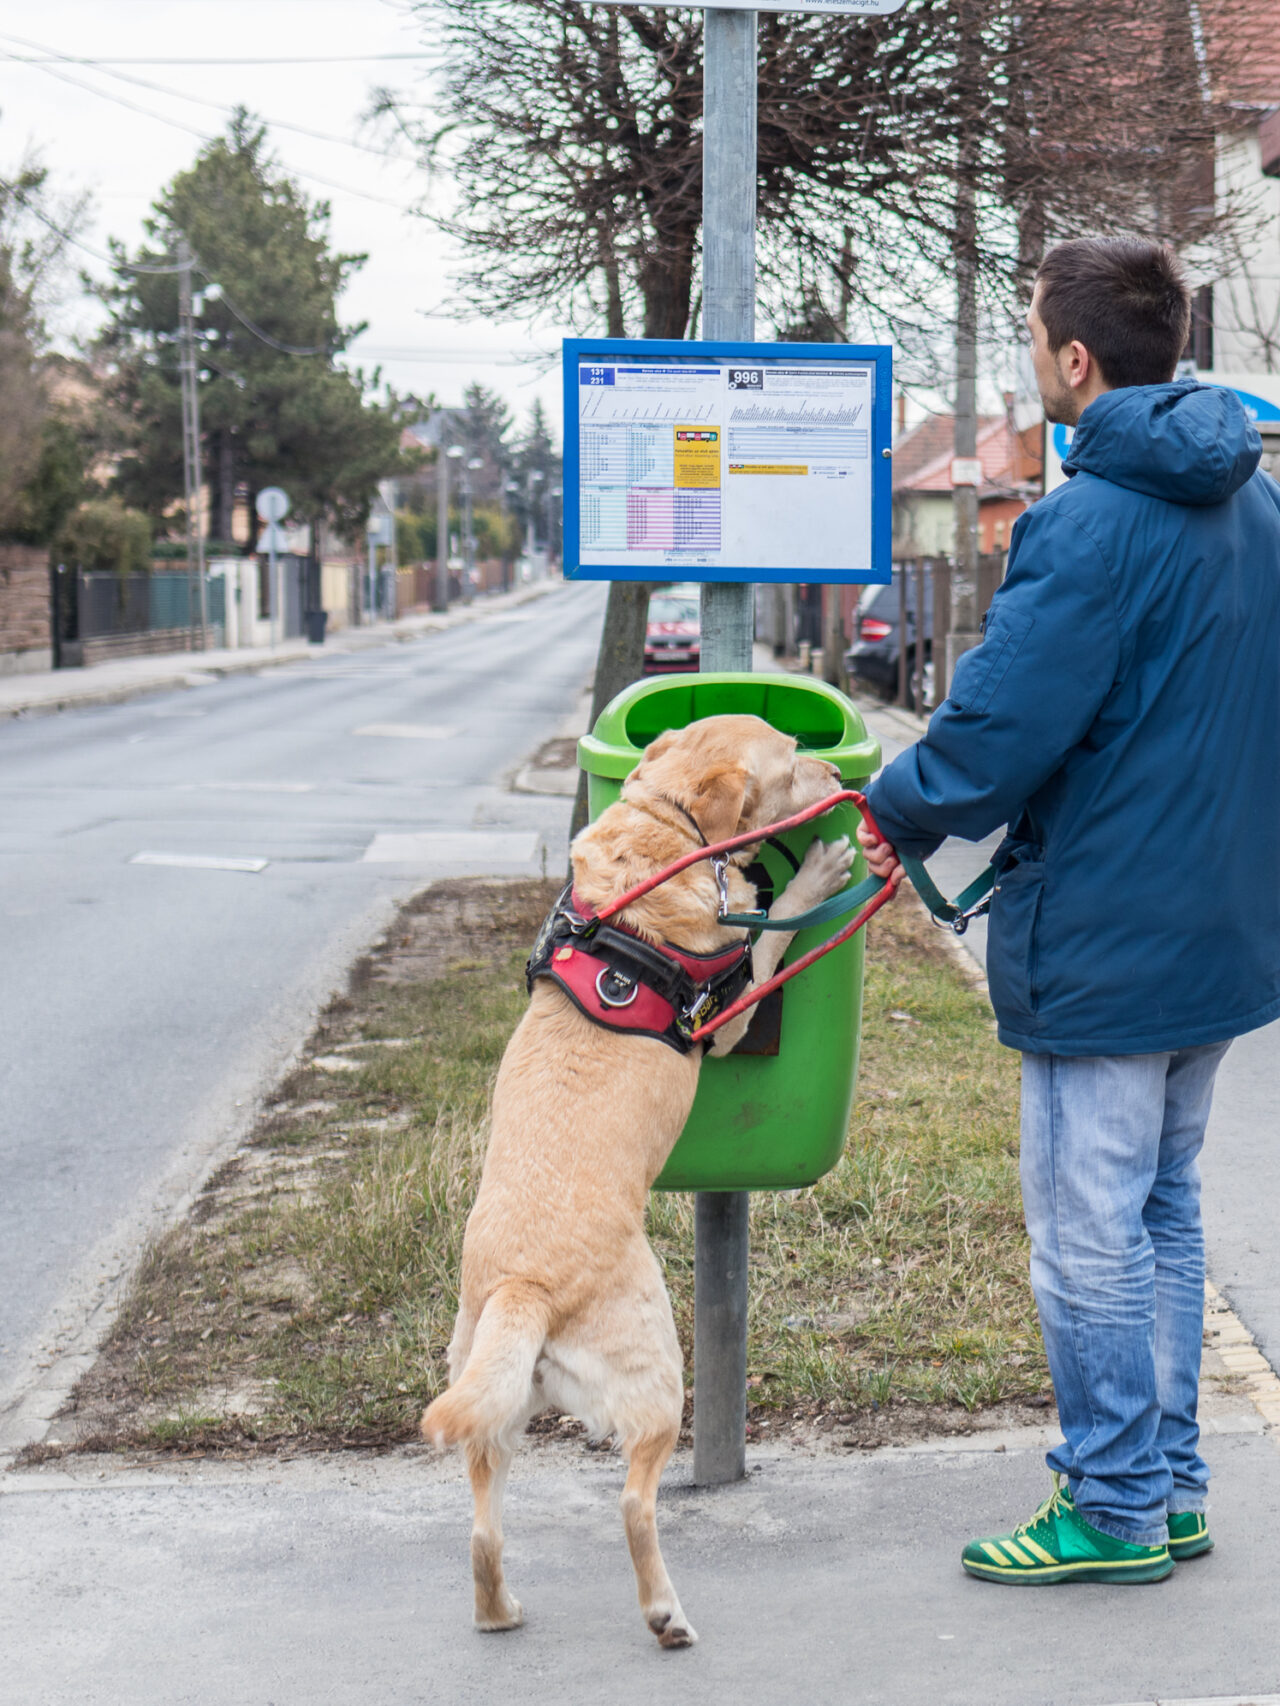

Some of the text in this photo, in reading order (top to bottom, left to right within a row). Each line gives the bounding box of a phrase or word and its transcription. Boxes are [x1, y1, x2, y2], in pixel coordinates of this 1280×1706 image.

[590, 368, 604, 376] 131
[590, 377, 604, 385] 231
[733, 371, 759, 384] 996
